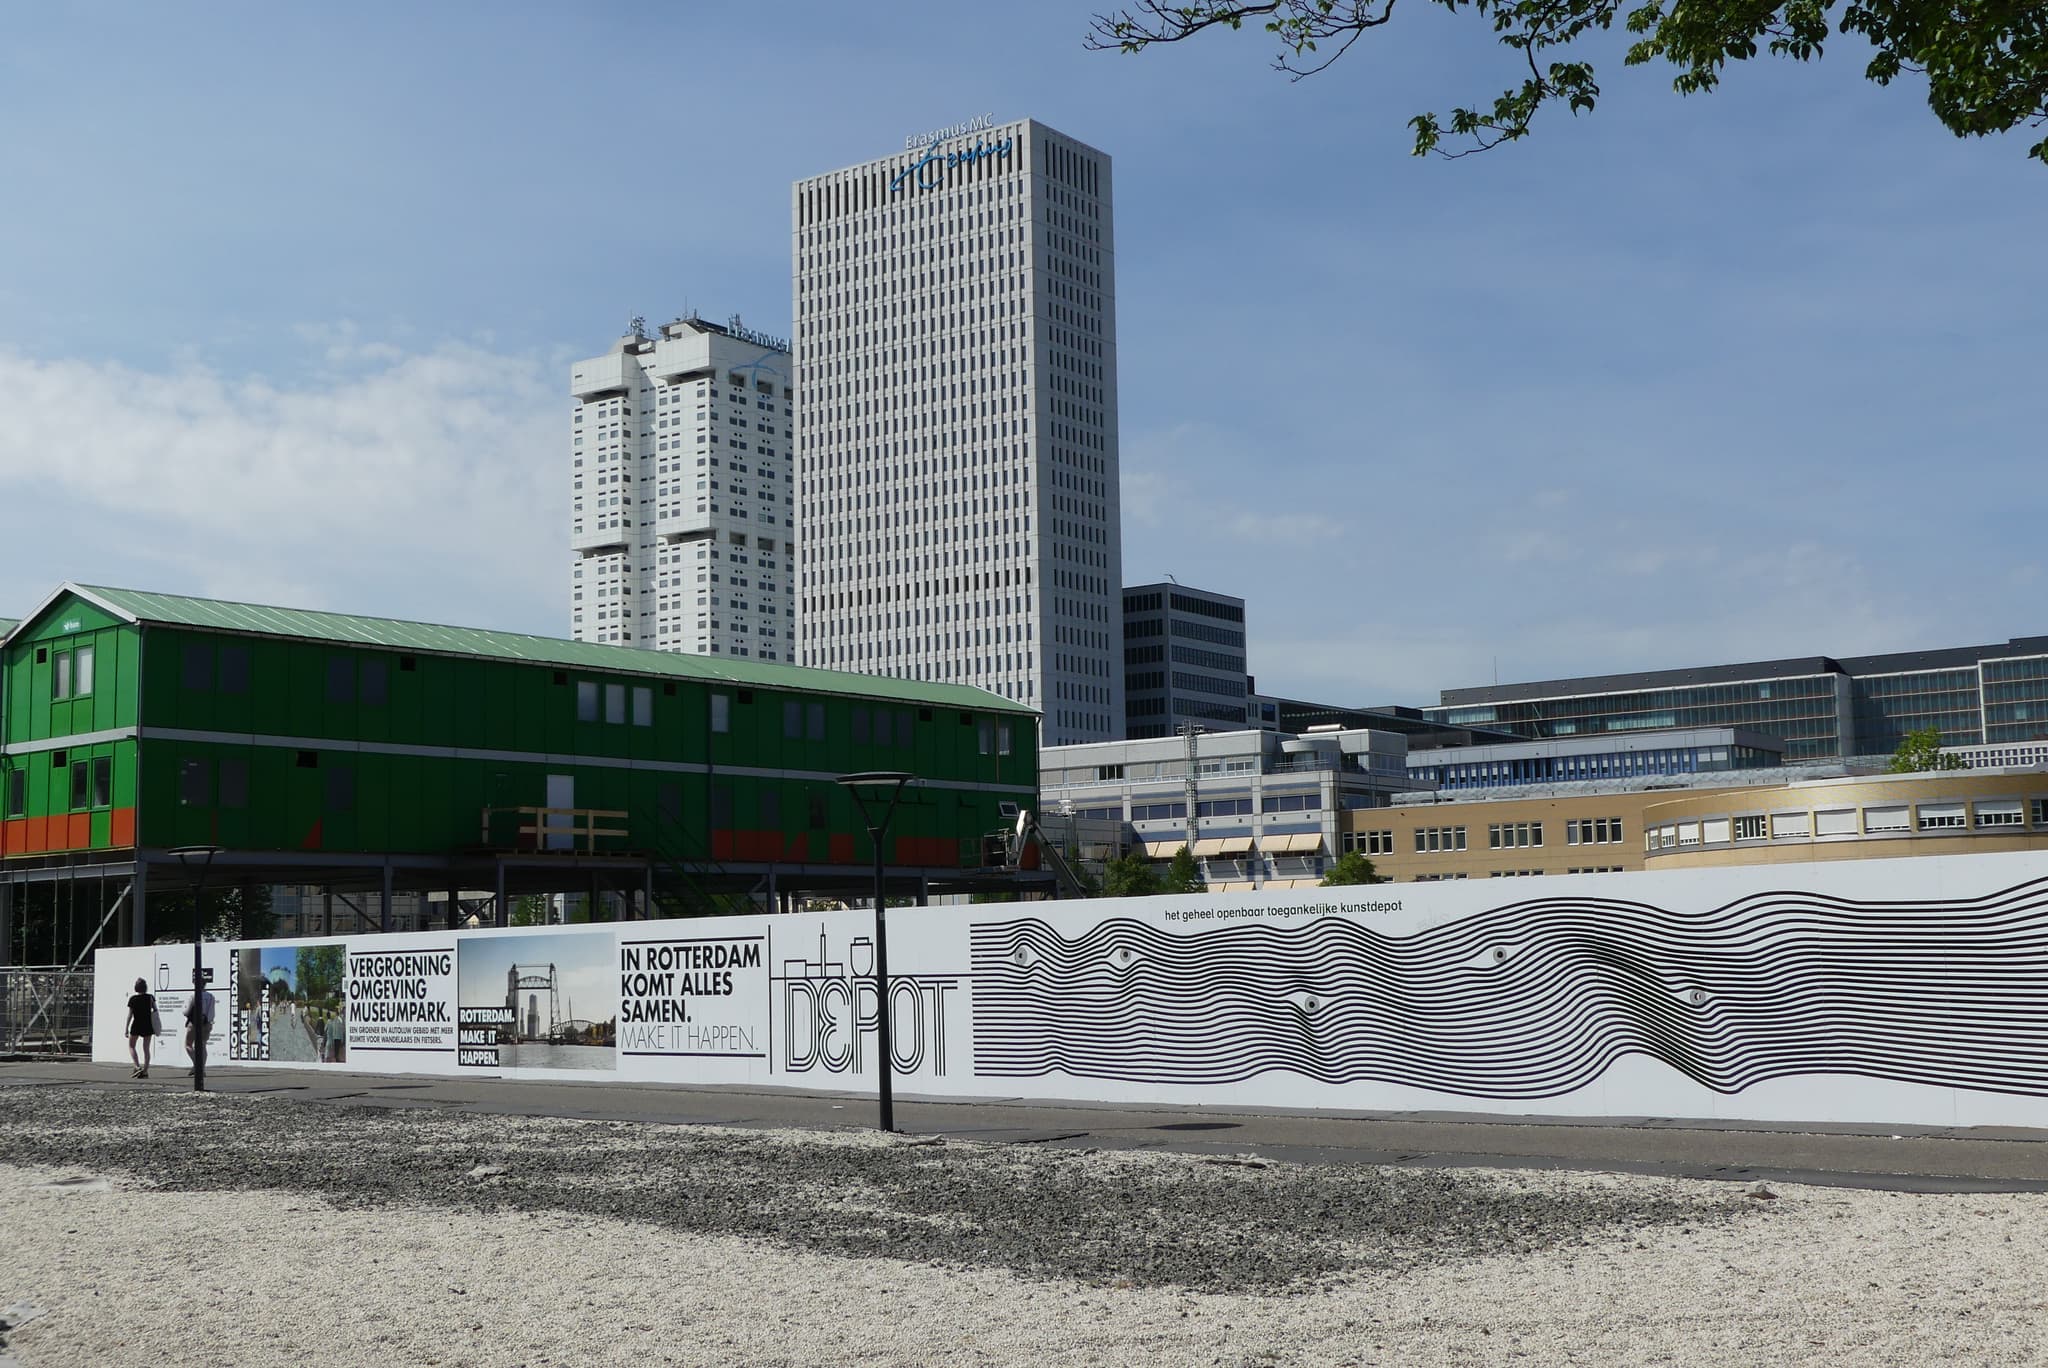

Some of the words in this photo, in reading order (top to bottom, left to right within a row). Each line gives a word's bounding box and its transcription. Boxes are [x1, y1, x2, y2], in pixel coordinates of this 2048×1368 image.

[905, 122, 968, 150] Erasmus
[969, 112, 994, 132] MC
[1165, 909, 1180, 921] het
[1182, 908, 1215, 923] geheel
[1217, 906, 1265, 921] openbaar
[1267, 902, 1338, 918] toegankelijke
[1340, 899, 1403, 914] kunstdepot
[349, 954, 452, 978] VERGROENING
[621, 948, 640, 971] IN
[647, 943, 761, 970] ROTTERDAM
[349, 978, 428, 1001] OMGEVING
[621, 973, 675, 997] KOMT
[680, 971, 733, 996] ALLES
[231, 951, 239, 1059] ROTTERDAM.
[349, 1001, 452, 1023] MUSEUMPARK.
[460, 1009, 516, 1023] ROTTERDAM.
[621, 999, 692, 1023] SAMEN.
[261, 983, 270, 1059] HAPPEN.
[240, 1010, 249, 1059] MAKE
[460, 1030, 485, 1043] MAKE
[488, 1030, 497, 1044] IT
[620, 1025, 665, 1049] MAKE
[671, 1025, 683, 1049] IT
[688, 1025, 759, 1050] HAPPEN.
[251, 1045, 259, 1059] IT
[460, 1050, 499, 1065] HAPPEN.
